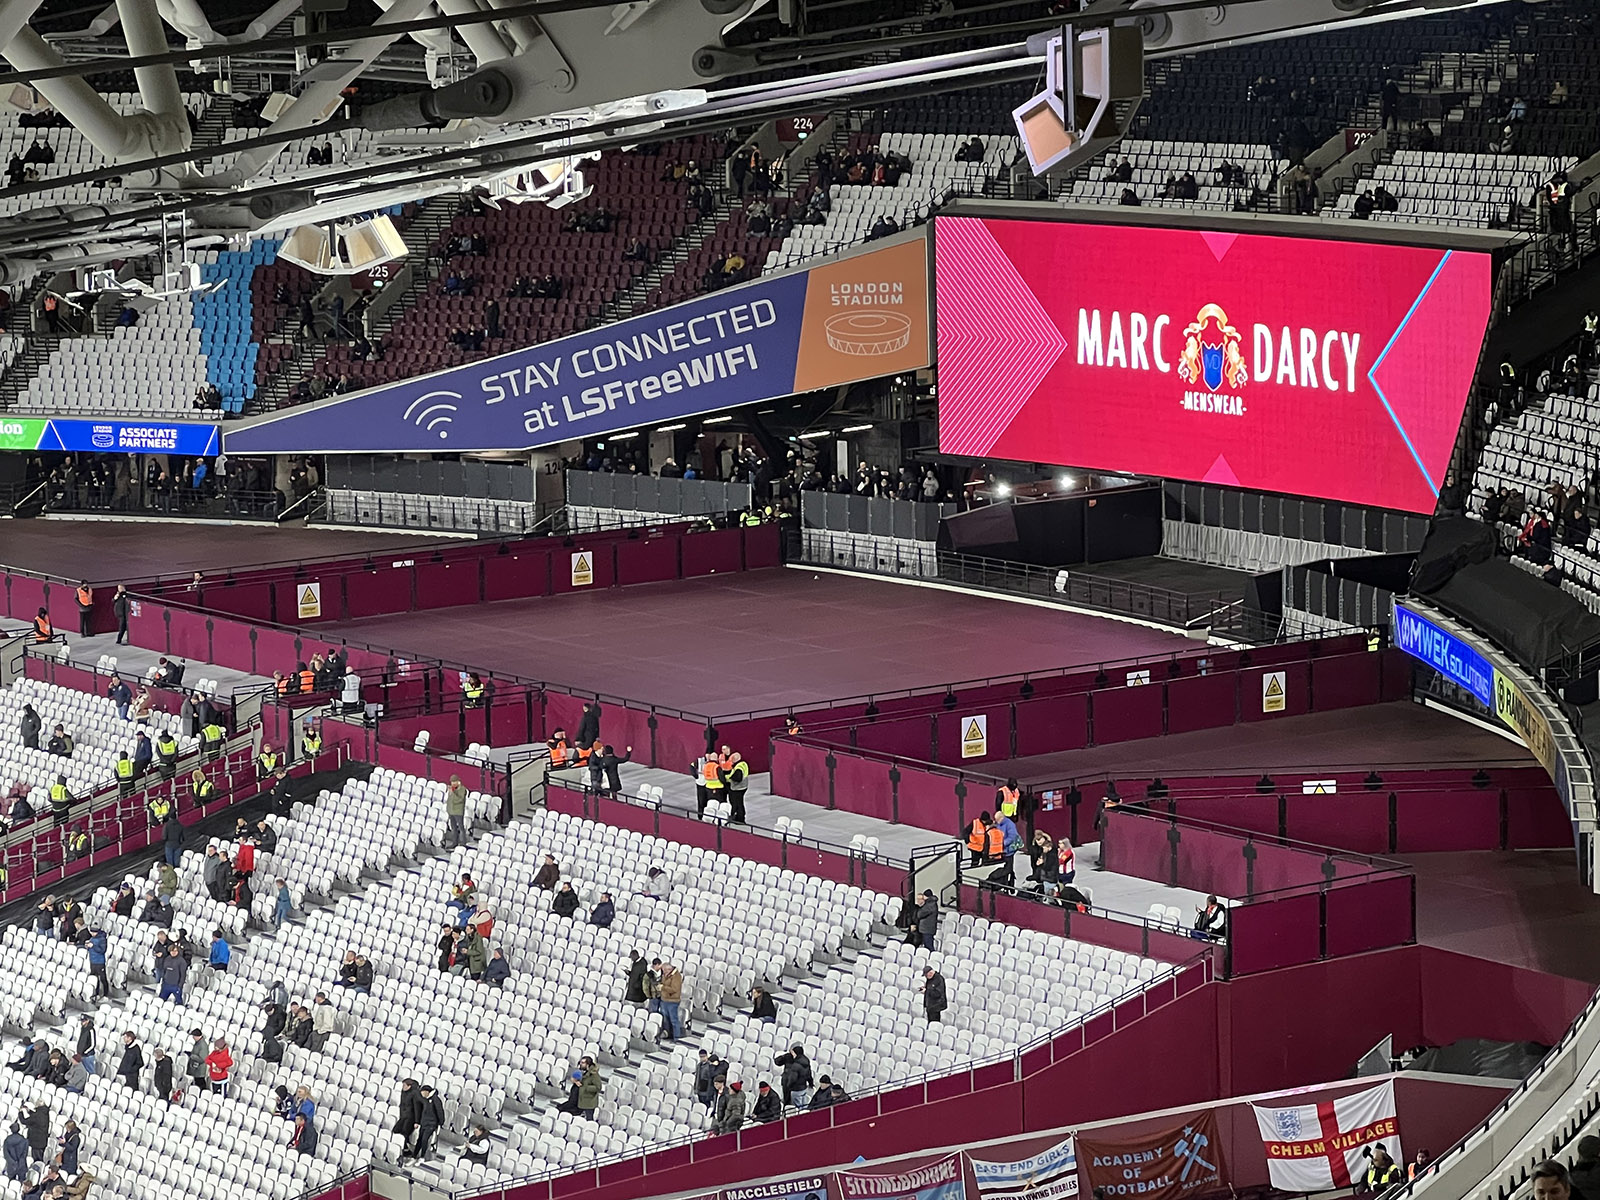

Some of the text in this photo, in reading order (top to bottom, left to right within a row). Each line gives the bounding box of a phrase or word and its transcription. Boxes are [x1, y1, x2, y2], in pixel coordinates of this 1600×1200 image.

[793, 117, 814, 130] 224
[368, 265, 389, 278] 225
[830, 282, 903, 294] LONDON
[831, 294, 903, 306] STADIUM
[480, 298, 777, 405] STAY CONNECTED
[1077, 308, 1360, 393] MARC DARCY
[523, 343, 759, 434] at LSFreeWIFI
[119, 427, 178, 439] ASSOCIATE
[119, 437, 176, 449] PARTNERS
[1270, 1121, 1395, 1156] CHEAM VILLAGE
[975, 1144, 1070, 1174] EAST END GIRLS
[1093, 1147, 1163, 1167] ACADEMY
[845, 1159, 957, 1195] SITTINGBOURNE
[1123, 1167, 1142, 1180] OF
[726, 1178, 822, 1200] MACCLESFIELD
